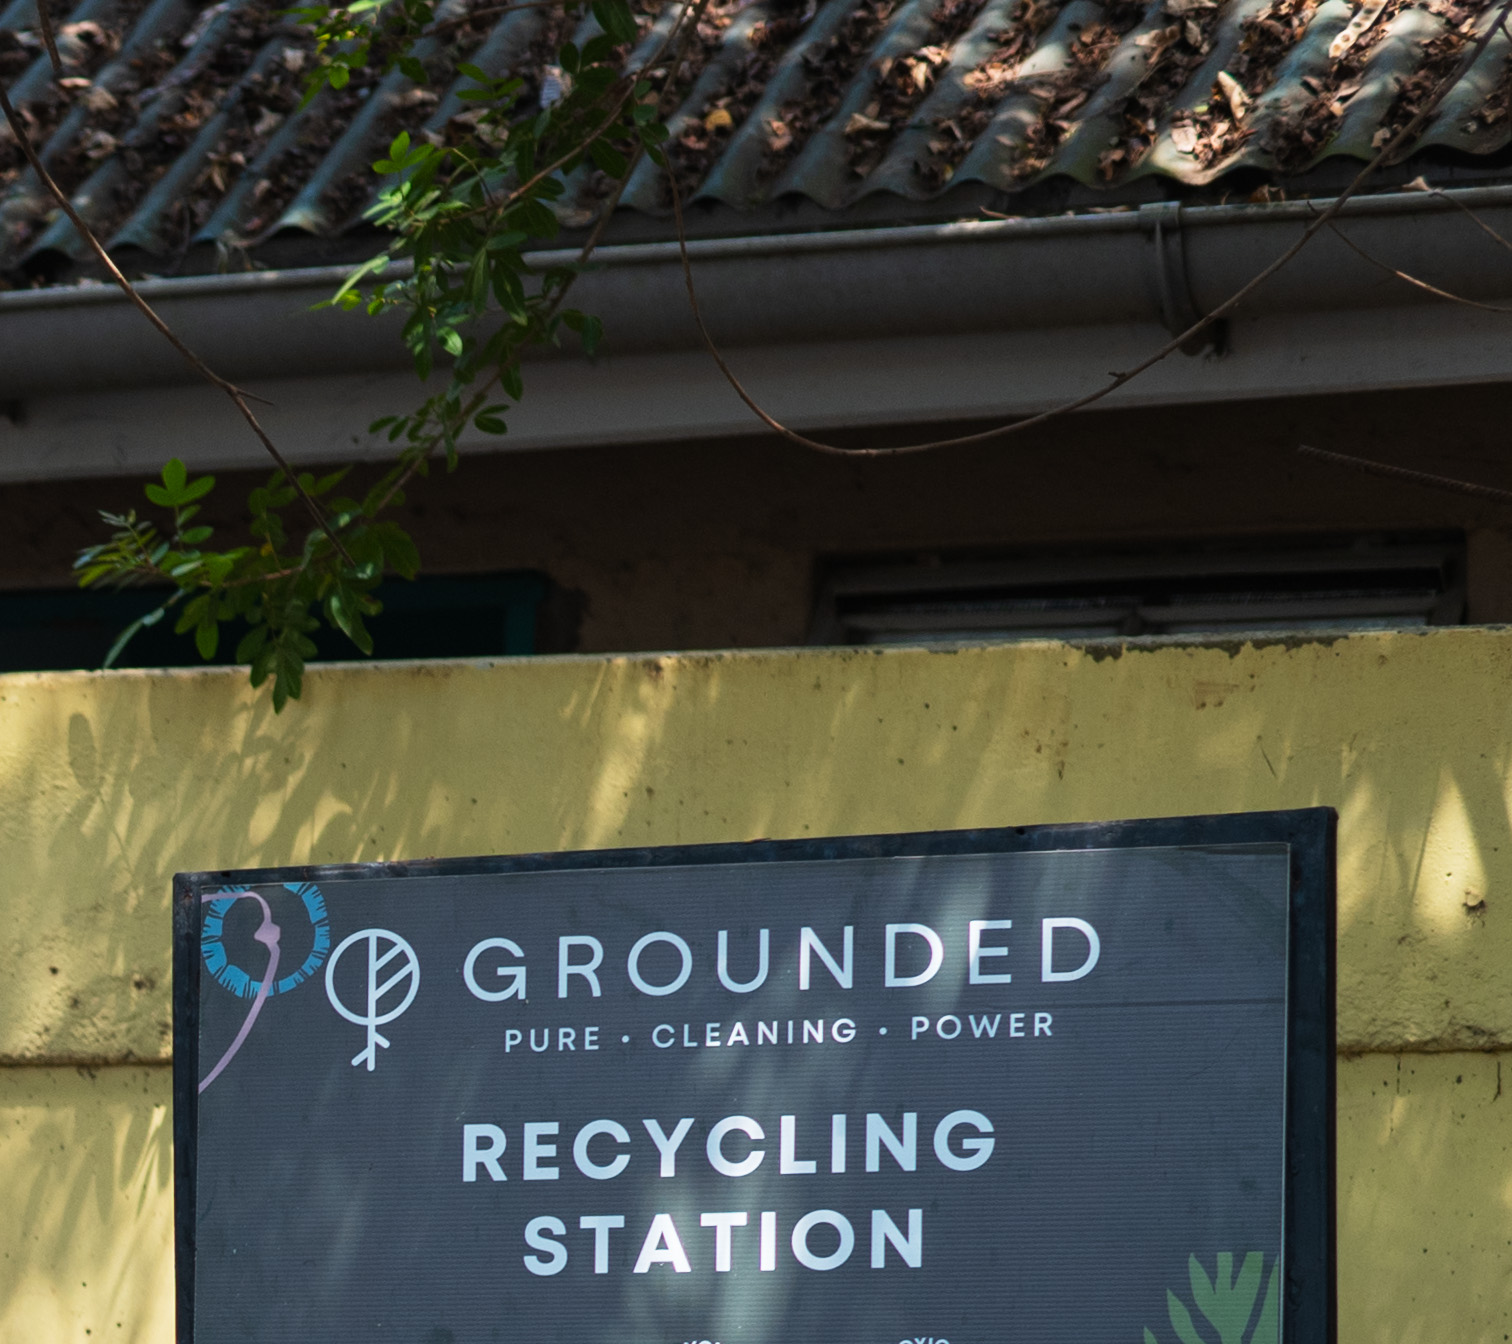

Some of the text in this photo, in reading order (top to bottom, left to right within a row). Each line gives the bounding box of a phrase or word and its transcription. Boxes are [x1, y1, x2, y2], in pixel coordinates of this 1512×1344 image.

[463, 917, 1099, 1001] GROUNDED
[505, 1012, 1052, 1052] PURE CLEANING POWER
[463, 1109, 995, 1182] RECYCLING
[523, 1208, 922, 1276] STATION
